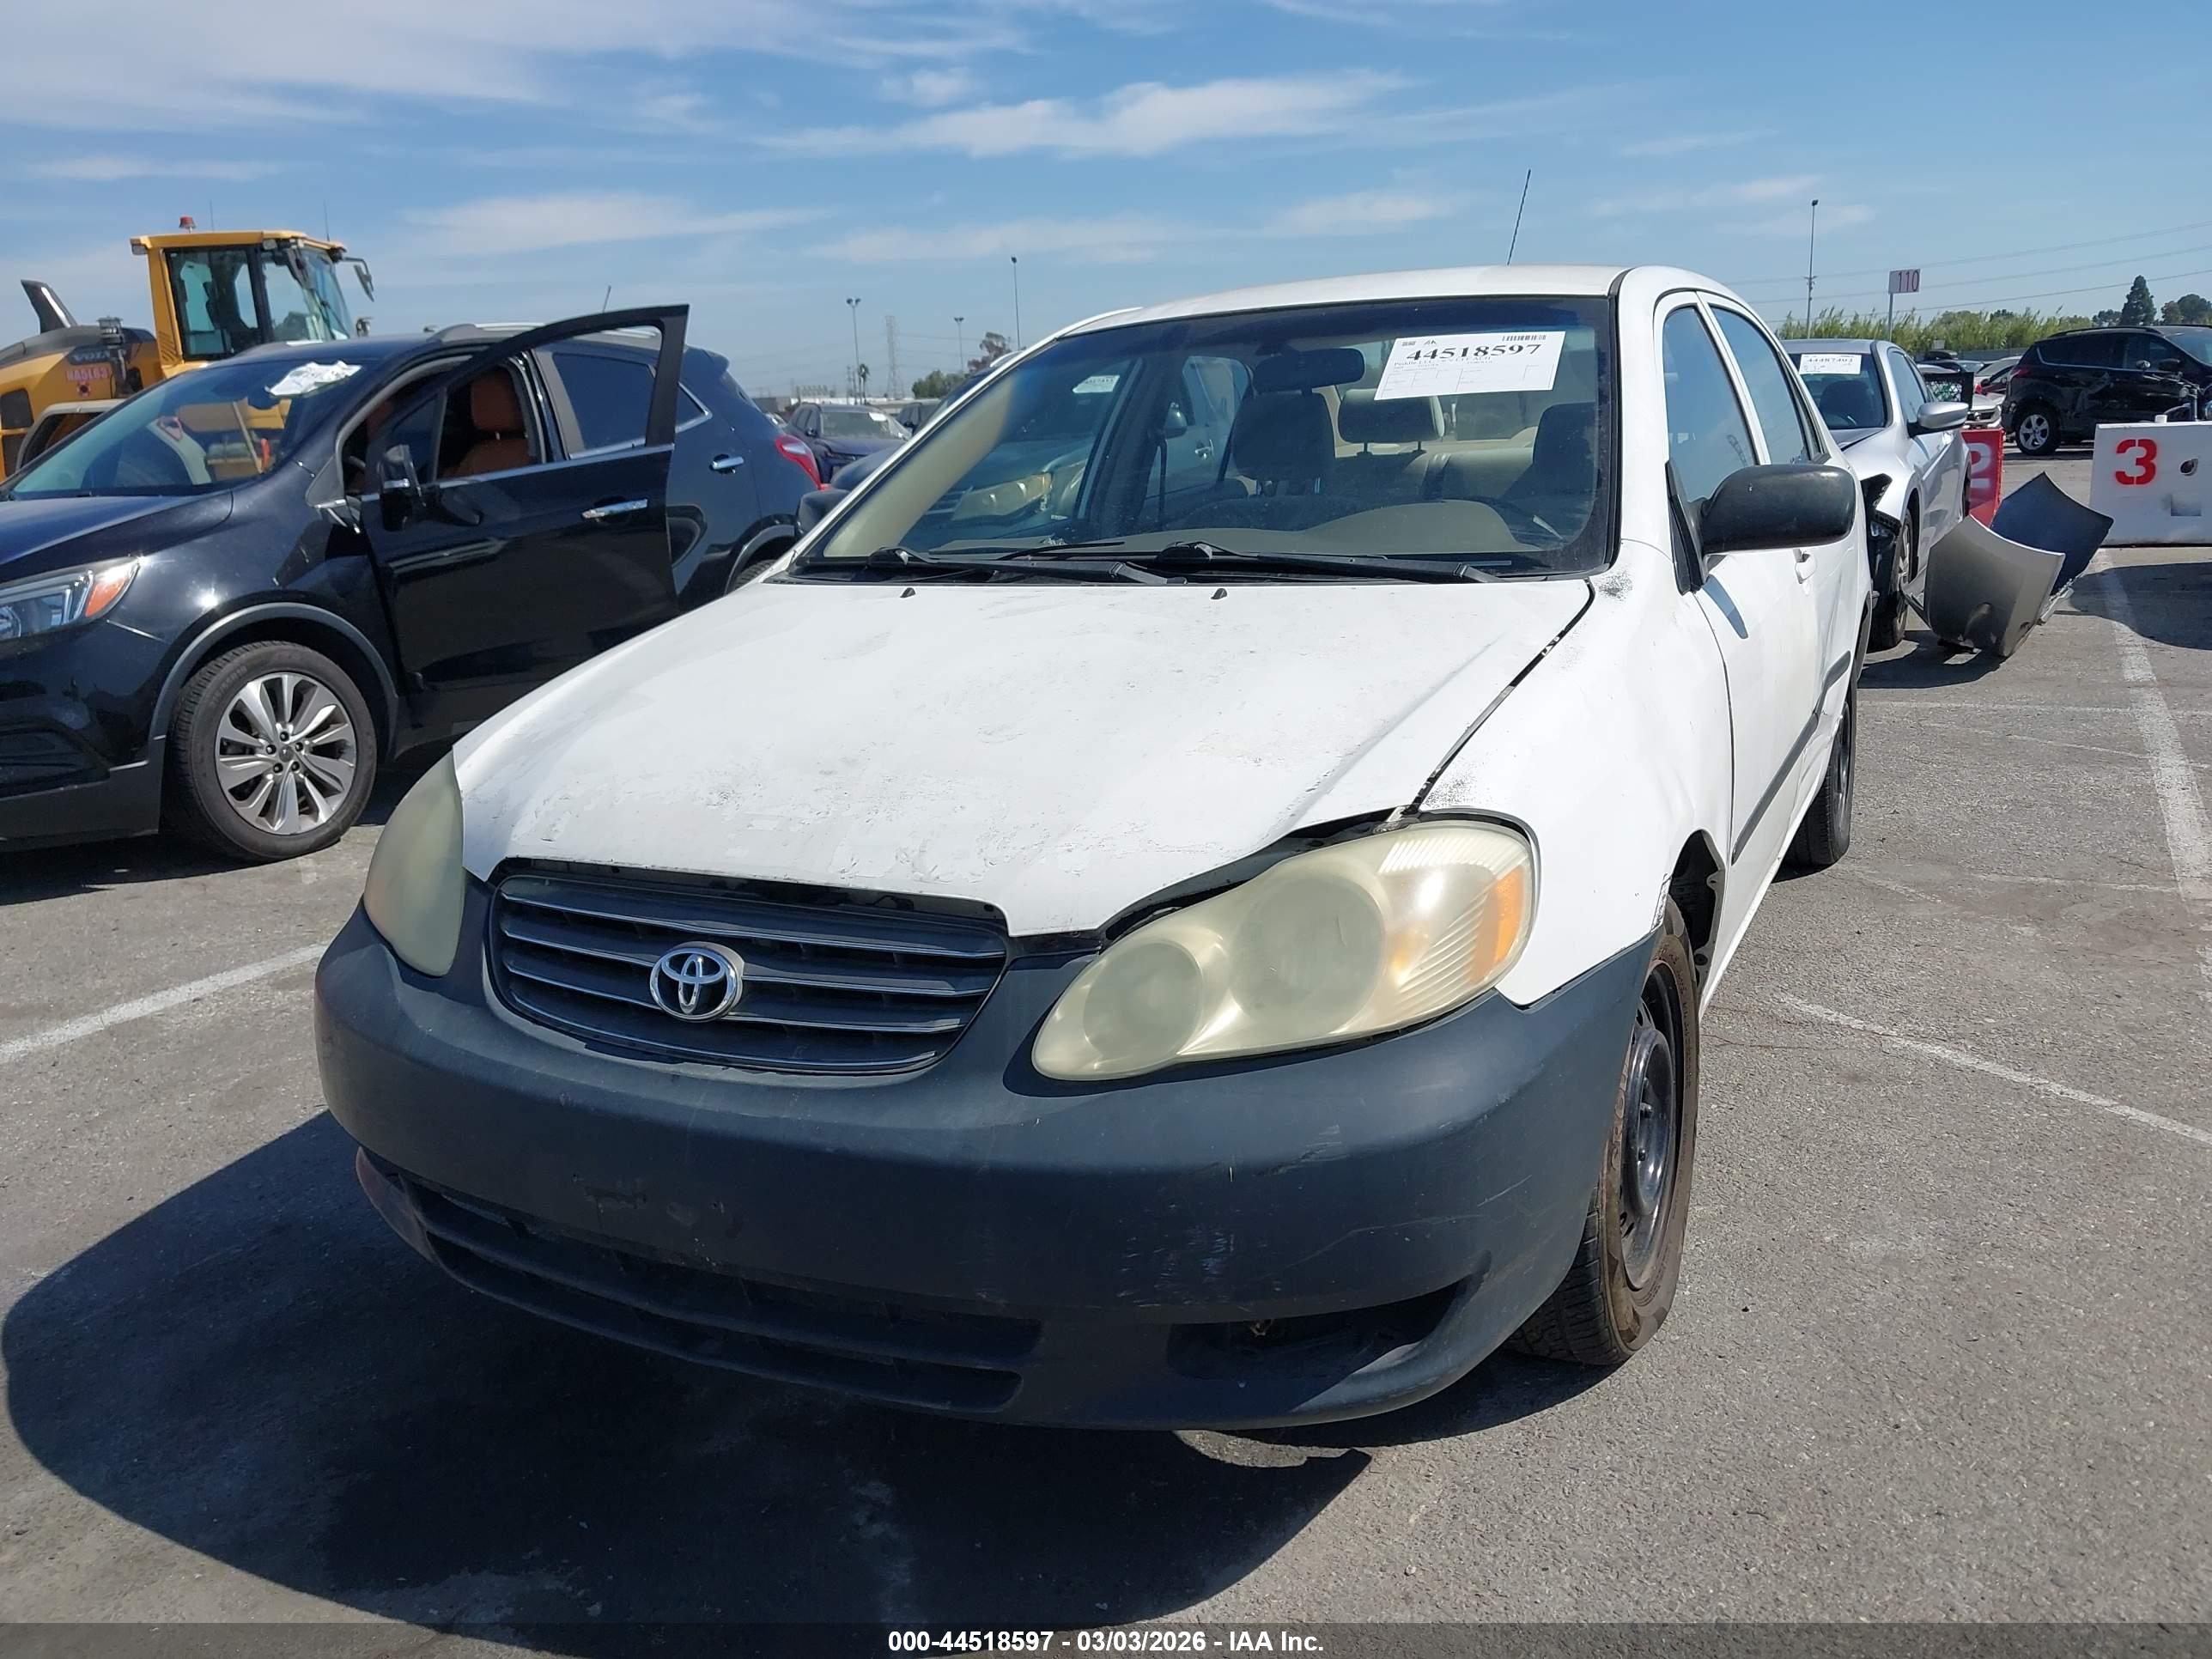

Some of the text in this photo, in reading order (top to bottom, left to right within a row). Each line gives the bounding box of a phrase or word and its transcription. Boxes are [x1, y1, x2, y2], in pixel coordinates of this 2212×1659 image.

[1898, 270, 1920, 292] 110
[1406, 344, 1541, 361] 44518597
[2115, 438, 2158, 486] 3
